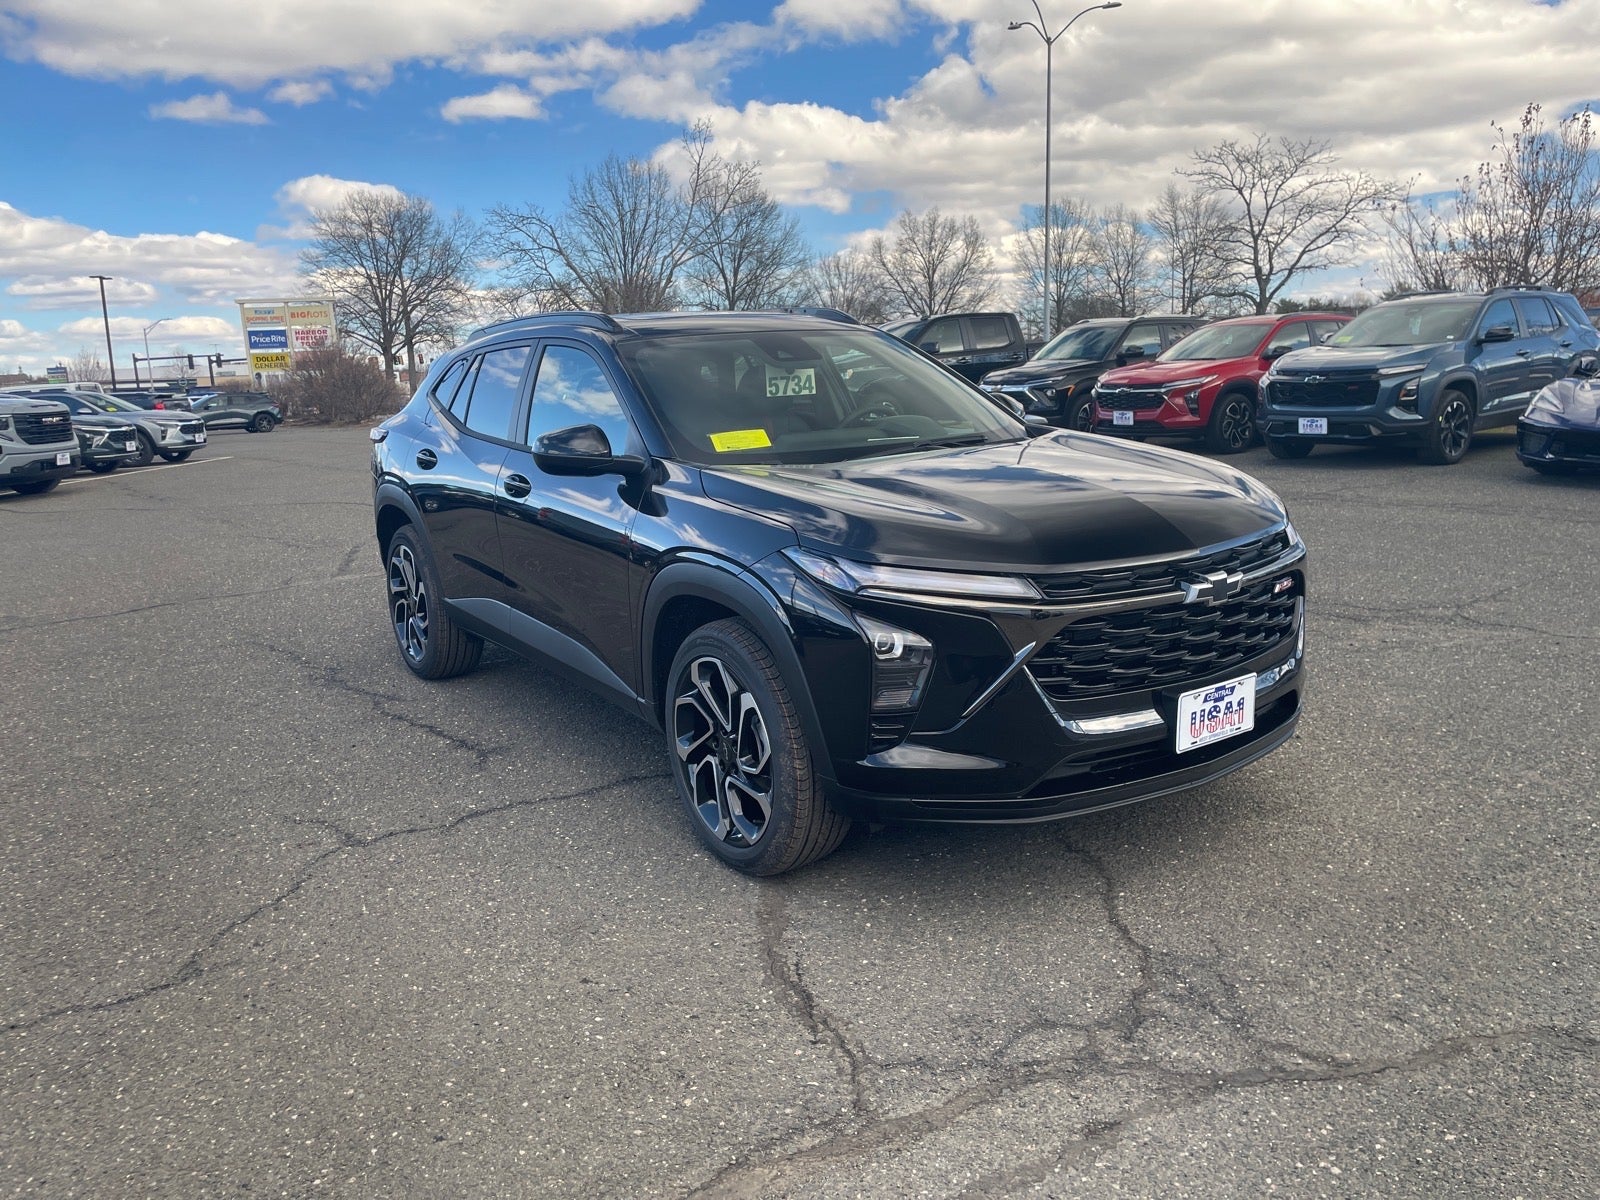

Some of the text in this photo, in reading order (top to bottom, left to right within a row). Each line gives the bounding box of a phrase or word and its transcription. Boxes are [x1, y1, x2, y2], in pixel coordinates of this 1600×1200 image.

[271, 335, 286, 343] Rite
[768, 375, 814, 396] 5734
[1206, 688, 1232, 701] CENTRAL
